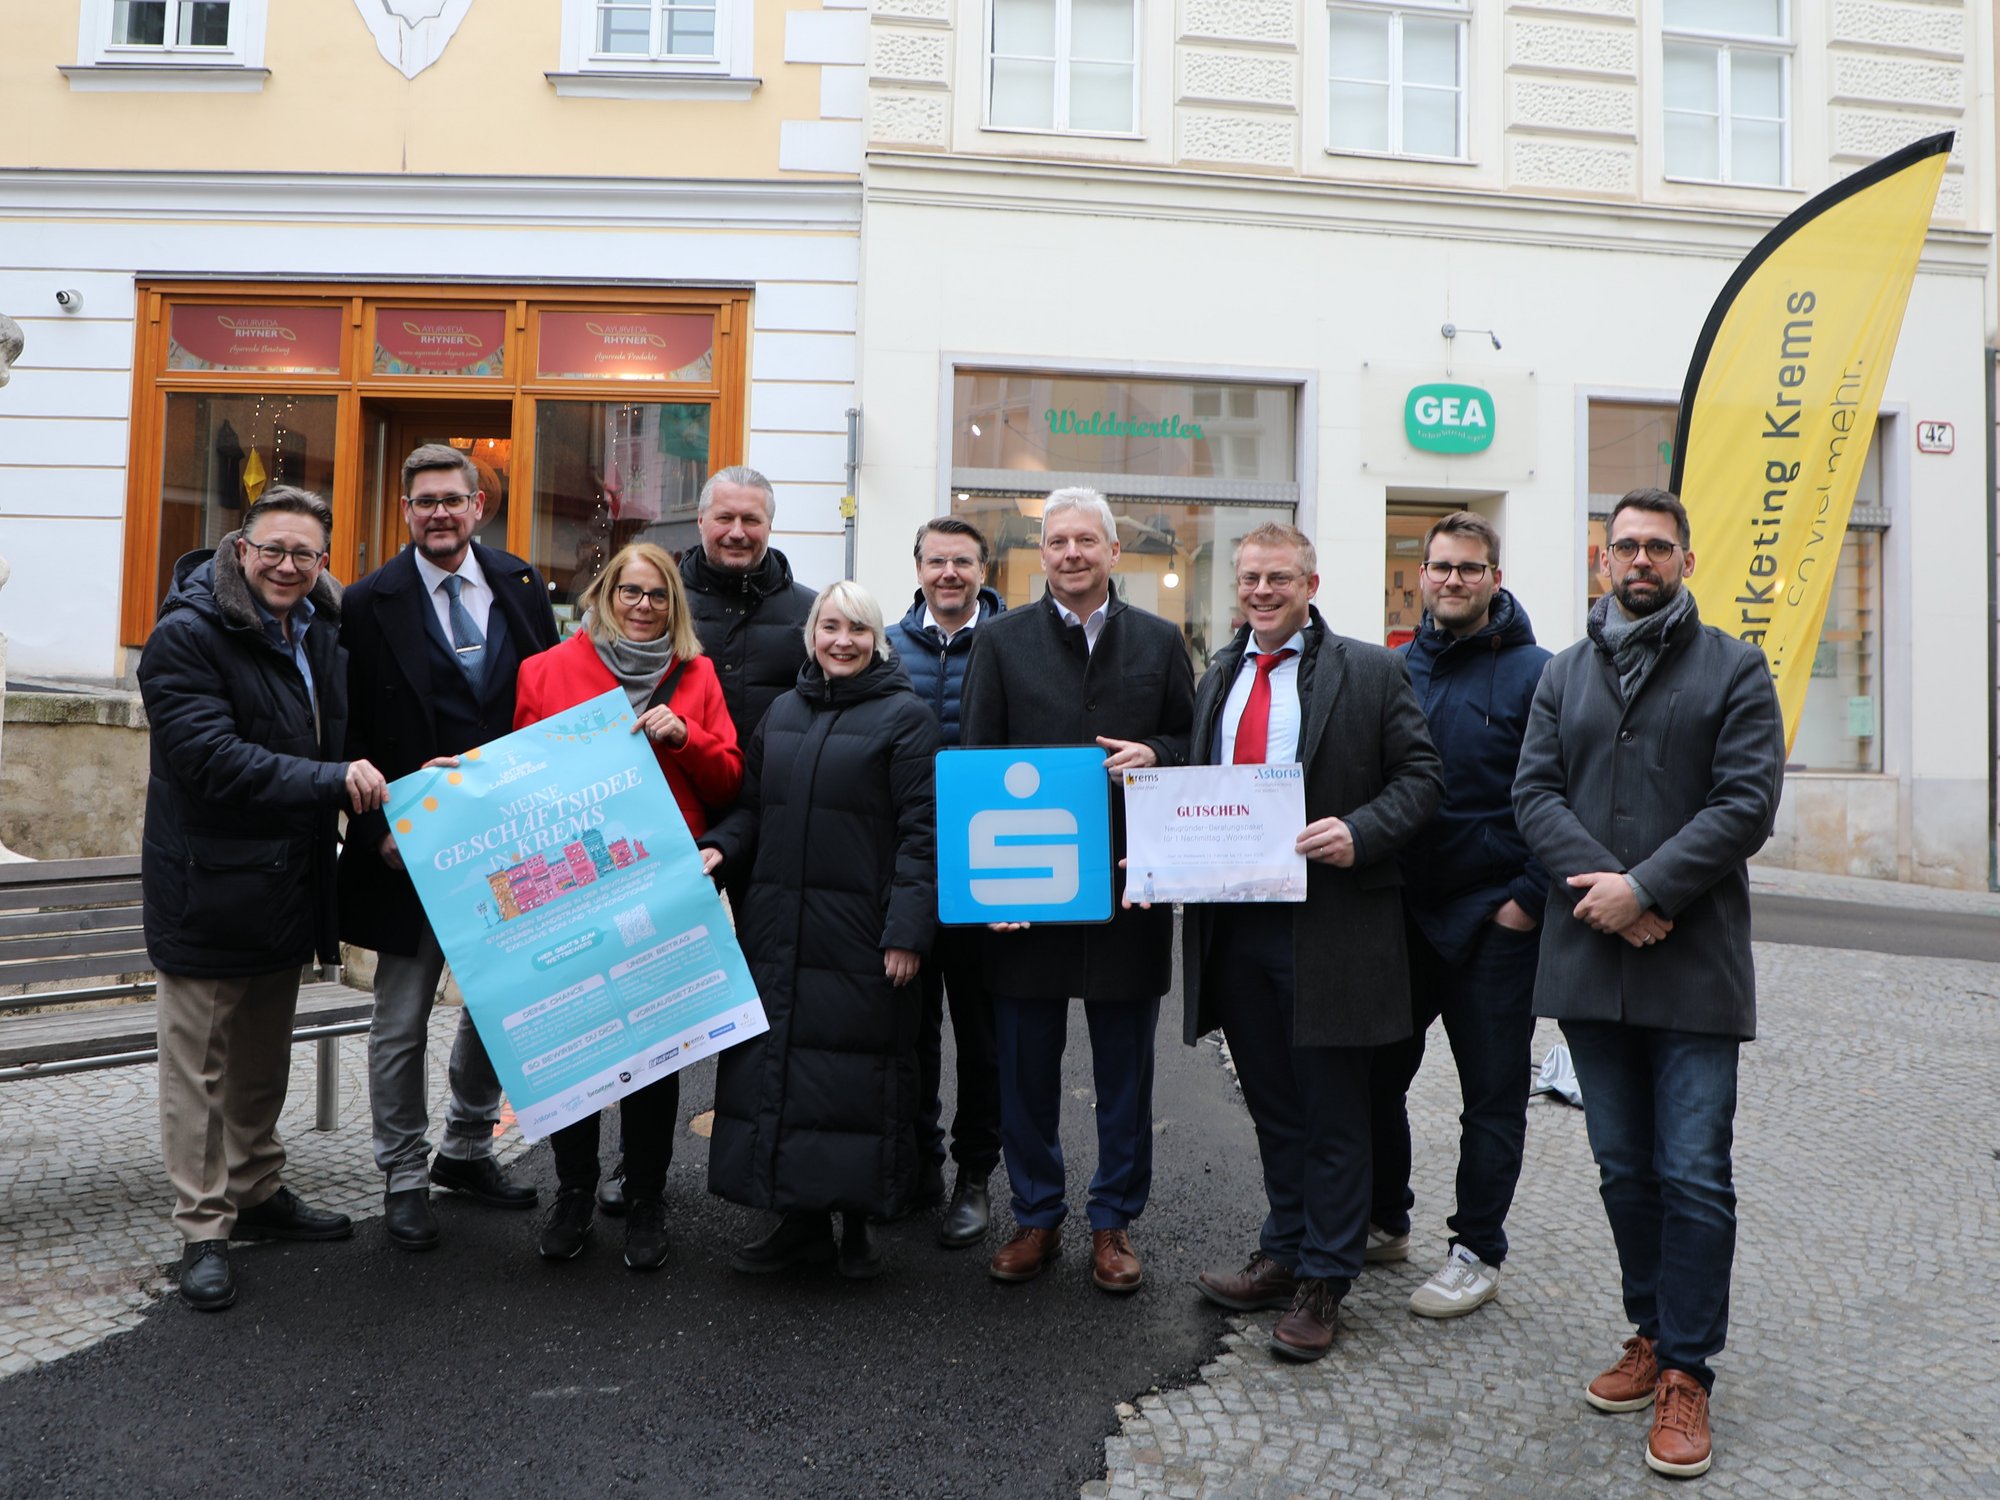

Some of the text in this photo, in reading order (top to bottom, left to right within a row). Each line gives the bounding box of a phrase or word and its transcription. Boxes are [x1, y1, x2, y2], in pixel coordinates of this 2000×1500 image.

[236, 319, 279, 327] AYURVEDA
[421, 325, 464, 333] AYURVEDA
[604, 325, 648, 333] AYURVEDA
[235, 329, 278, 338] RHYNER
[420, 335, 464, 344] RHYNER
[603, 336, 647, 345] RHYNER
[594, 351, 657, 361] Ayurveda Produkte
[1414, 395, 1487, 427] GEA
[1044, 408, 1205, 440] Waldviertler
[1925, 423, 1947, 442] 47
[1735, 290, 1817, 651] arketing Krems
[500, 783, 563, 820] MEINE
[1177, 804, 1250, 817] GUTSCHEIN
[433, 766, 642, 871] GESCHÄFTSIDEE
[489, 805, 606, 871] IN KREMS
[1180, 833, 1221, 843] Nachmittag
[627, 935, 691, 968] UNSER BEITRAG
[523, 986, 584, 1018] DEINE CHANCE
[528, 1061, 539, 1070] SO
[542, 1040, 583, 1063] BEWIRBST
[585, 1034, 597, 1042] DU
[598, 1023, 617, 1035] DICH
